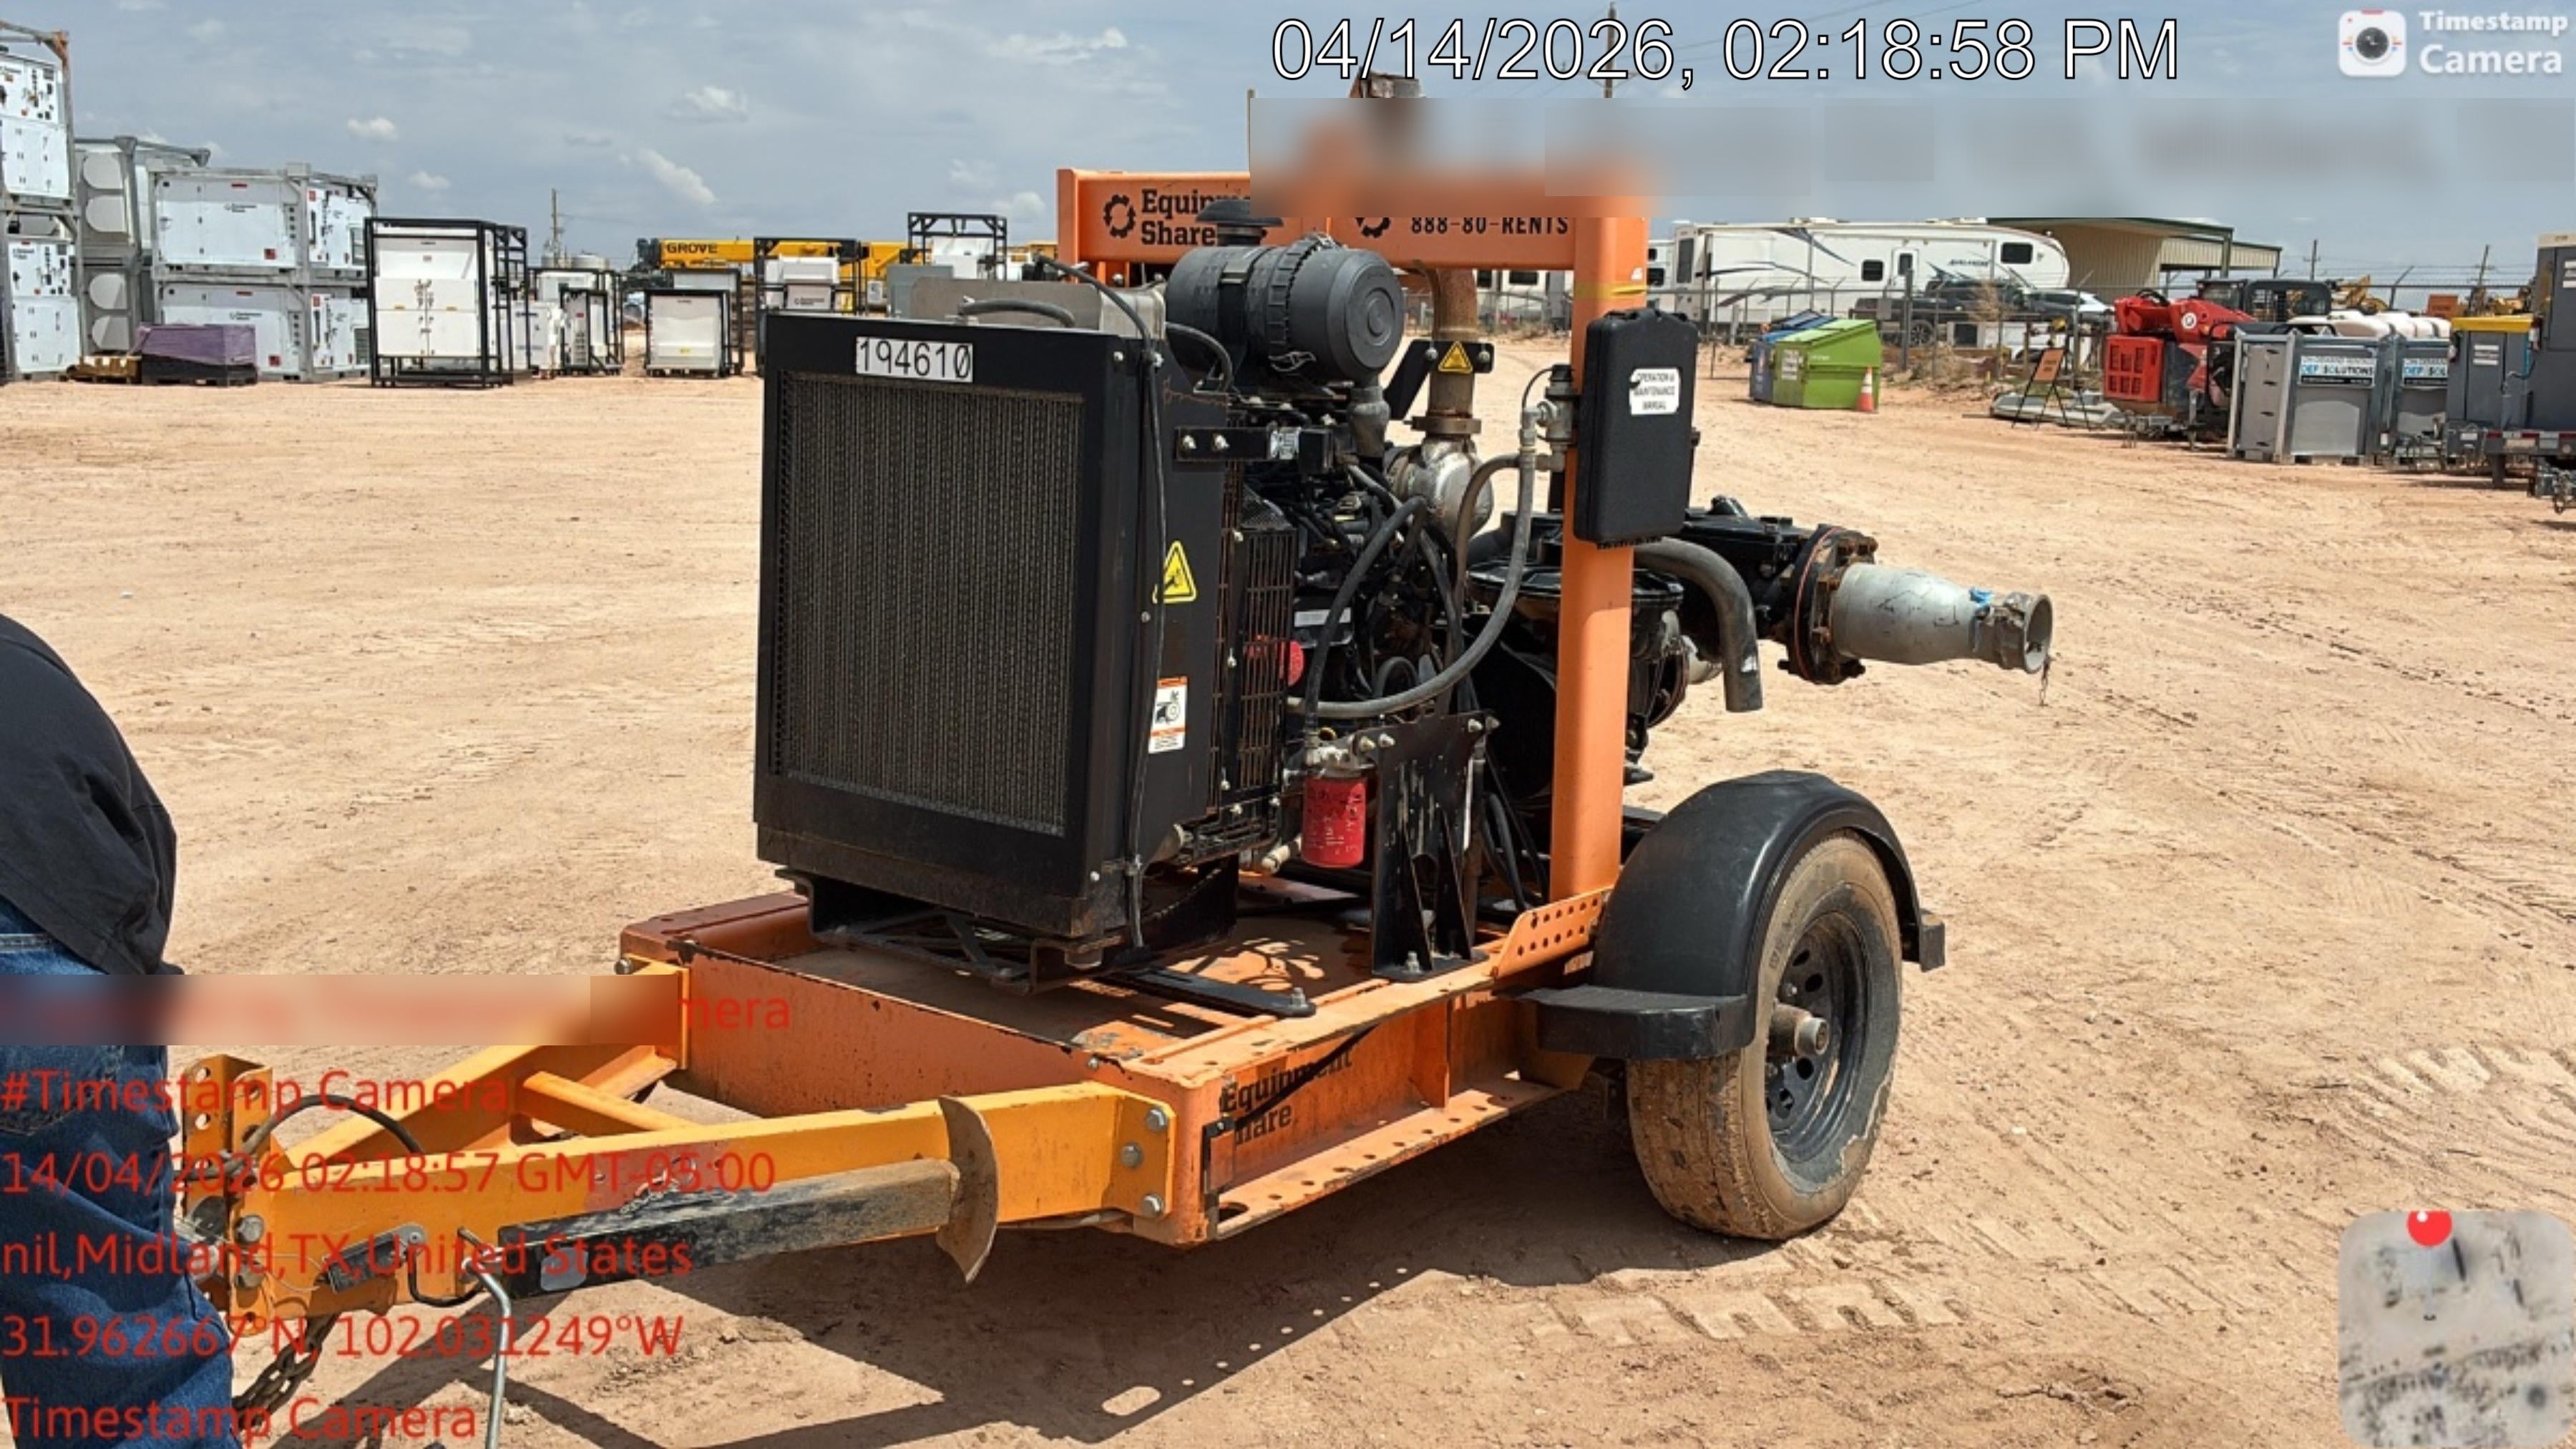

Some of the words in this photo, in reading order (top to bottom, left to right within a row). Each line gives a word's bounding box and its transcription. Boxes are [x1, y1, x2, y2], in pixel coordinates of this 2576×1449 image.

[1141, 220, 1216, 245] Share
[666, 242, 718, 254] GROVE
[860, 338, 971, 379] 194610
